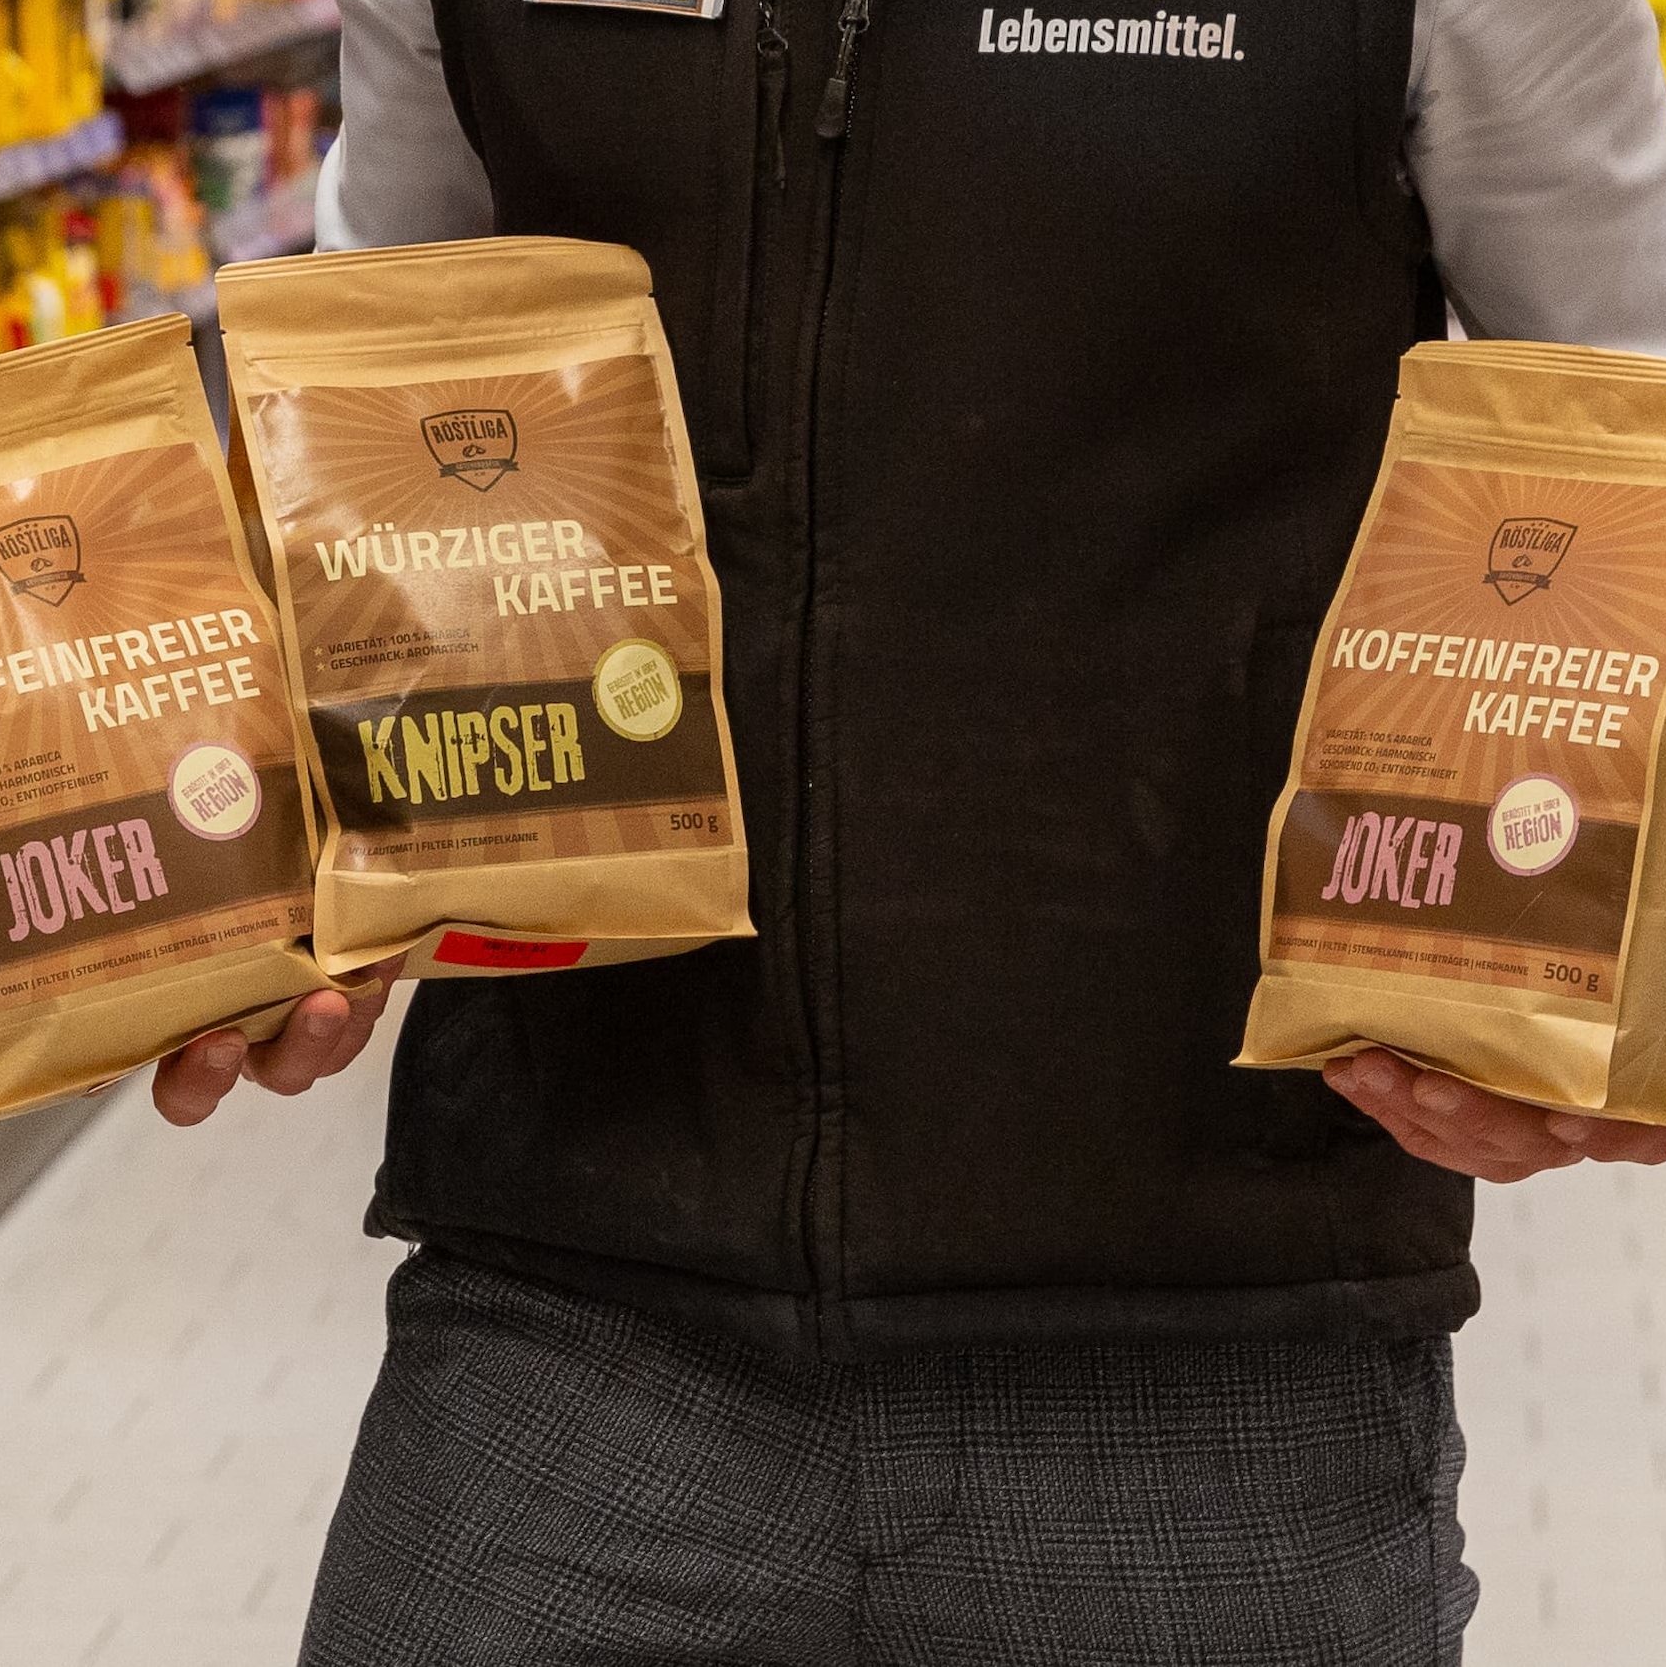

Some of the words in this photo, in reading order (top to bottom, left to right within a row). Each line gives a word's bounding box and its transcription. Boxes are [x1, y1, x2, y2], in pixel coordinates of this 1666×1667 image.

[978, 8, 1245, 61] Lebensmittel.
[430, 418, 508, 444] RÖSTLIGA
[314, 519, 587, 582] WÜRZIGER
[1499, 527, 1566, 553] RÖSTLIGA
[493, 565, 678, 617] KAFFEE
[328, 636, 388, 655] VARIETÄT:
[390, 632, 411, 645] 100
[330, 650, 406, 670] GESCHMACK:
[406, 642, 479, 659] AROMATISCH
[1332, 628, 1659, 698] KOFFEINFREIER
[78, 656, 261, 733] KAFFEE
[613, 672, 670, 720] REGION
[1463, 691, 1630, 749] KAFFEE
[358, 702, 585, 804] KNIPSER
[1322, 744, 1375, 758] GESCHMACK:
[1375, 746, 1437, 763] HARMONISCH
[1326, 730, 1368, 741] VARIETÄT:
[1369, 732, 1385, 743] 100
[1393, 734, 1433, 747] ARABICA
[14, 750, 62, 771] ARABICA
[1319, 759, 1363, 772] SCHONEND
[1381, 762, 1458, 780] ENTKOFFEINIERT
[0, 763, 76, 791] HARMONISCH
[16, 771, 110, 803] ENTKOFFEINIERT
[189, 768, 250, 822] REGION
[670, 812, 703, 831] 500
[707, 815, 719, 833] g
[1503, 811, 1563, 851] REGION
[421, 838, 454, 851] FILTER
[461, 832, 539, 848] STEMPELKANNE
[1321, 811, 1463, 909] JOKER
[0, 818, 169, 942] JOKER
[36, 969, 70, 987] FILTER
[75, 948, 153, 977] STEMPELKANNE
[223, 916, 280, 939] HERDKANNE
[1475, 960, 1530, 976] HERDKANNE
[1543, 962, 1582, 985] 500
[1586, 971, 1600, 993] g
